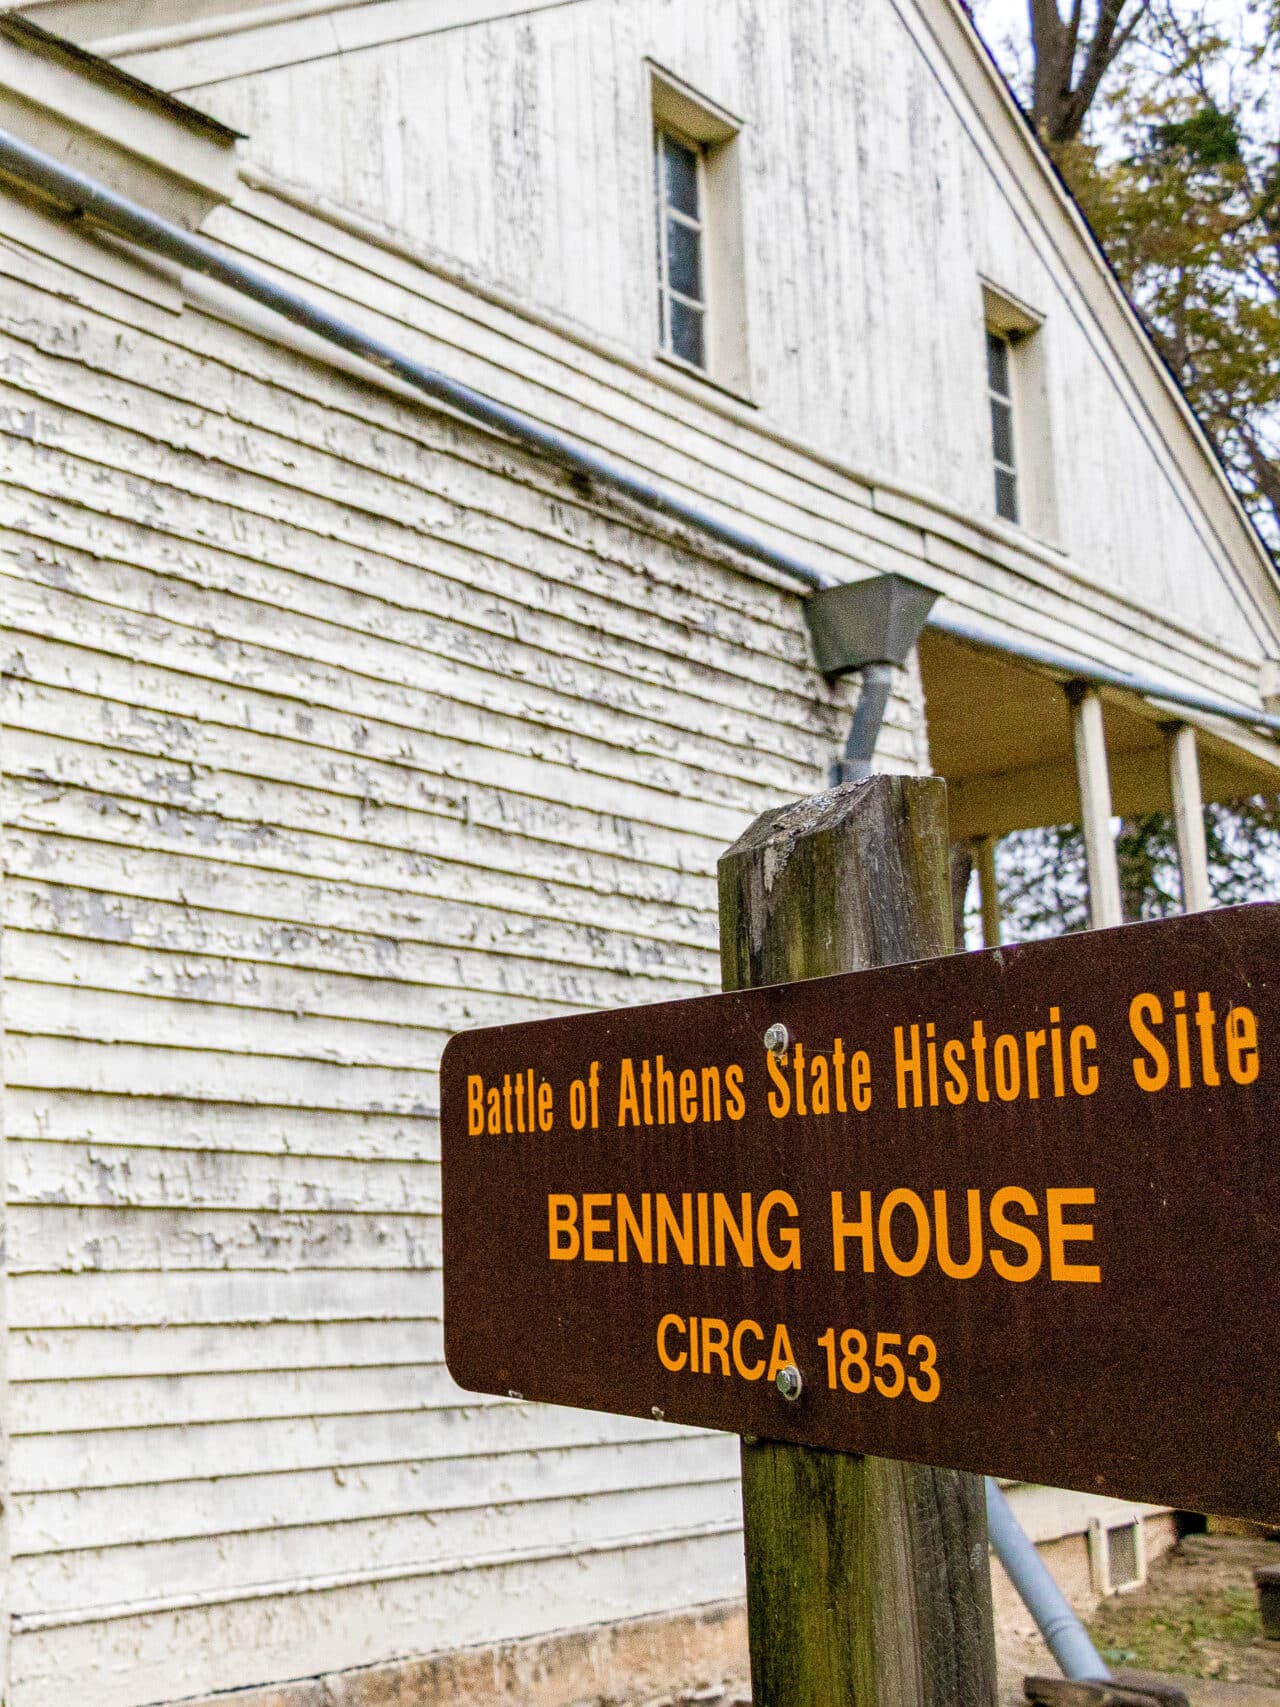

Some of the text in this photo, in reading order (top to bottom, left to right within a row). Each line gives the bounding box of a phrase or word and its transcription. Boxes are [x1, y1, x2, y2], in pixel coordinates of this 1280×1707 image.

[467, 990, 1260, 1136] Battle of Athens State Historic Site
[548, 1185, 1102, 1283] BENNING HOUSE
[656, 1313, 941, 1403] CIRCA 1853
